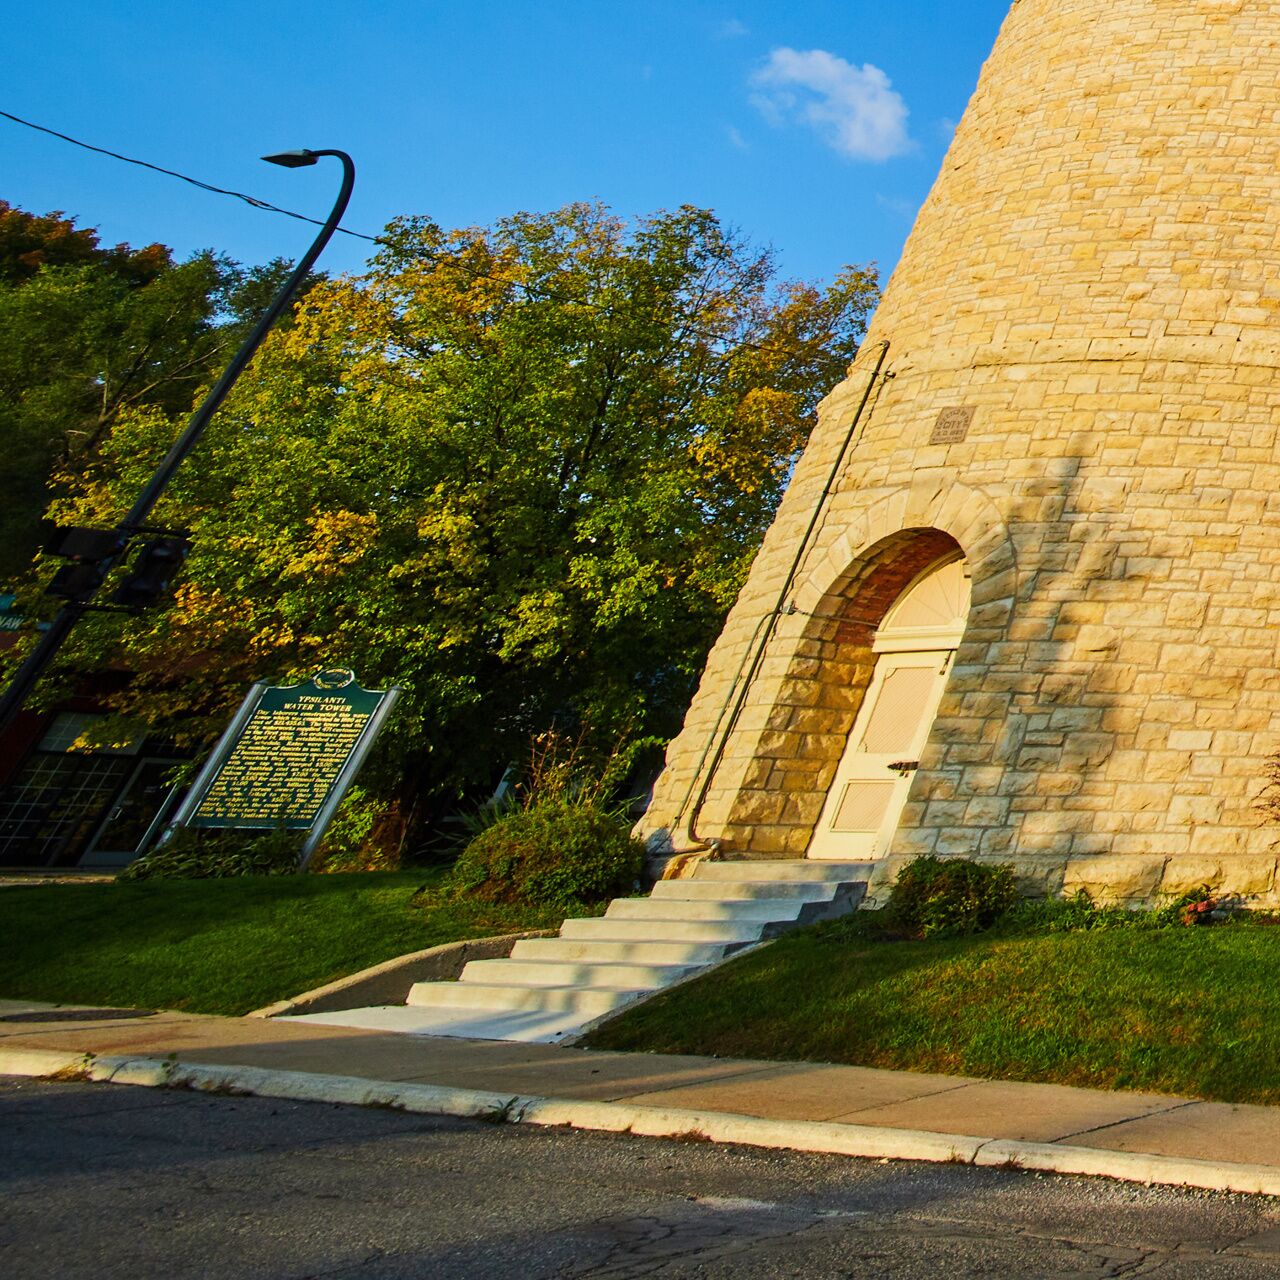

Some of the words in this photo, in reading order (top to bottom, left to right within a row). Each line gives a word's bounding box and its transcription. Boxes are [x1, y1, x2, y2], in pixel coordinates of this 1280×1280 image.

[296, 695, 347, 704] YPSILANTI
[281, 702, 315, 710] WATER
[317, 704, 353, 712] TOWER
